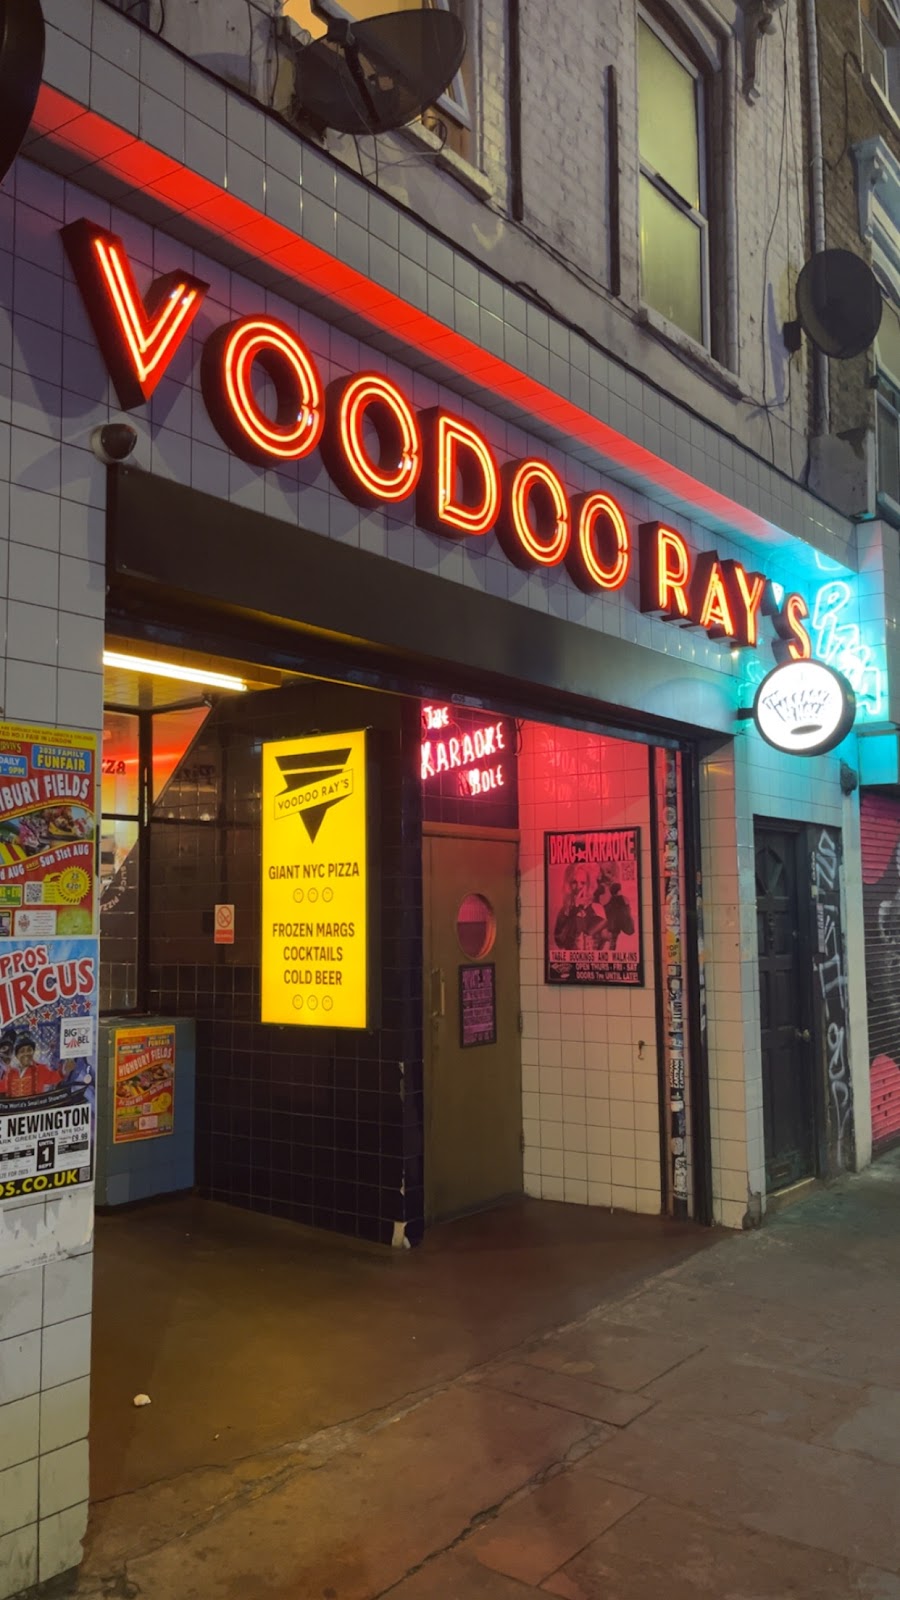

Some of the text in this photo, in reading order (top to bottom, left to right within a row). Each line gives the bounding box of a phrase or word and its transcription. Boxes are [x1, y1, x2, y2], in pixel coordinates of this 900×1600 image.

[62, 217, 812, 660] VOODOO RAY'S
[58, 749, 84, 757] FAMILY
[421, 722, 505, 779] KARAOKE
[38, 754, 86, 771] FUNFAIR
[44, 773, 90, 799] FIELDS
[278, 778, 349, 811] VOODOO RAY'S
[550, 831, 635, 865] DRAG KARAOKE
[8, 863, 25, 880] AUG
[40, 855, 55, 867] Sun
[55, 847, 71, 861] 31st
[73, 844, 90, 856] AUG
[269, 862, 360, 880] GIANT NYC PIZZA
[272, 922, 355, 938] FROZEN MARGS
[283, 946, 343, 962] COCKTAILS
[552, 952, 637, 962] TABLE BOOKINGS AND WALK-INS
[283, 969, 342, 986] COLD BEER
[64, 1028, 77, 1037] BIG
[118, 1046, 173, 1077] HIGHBURY FIELDS
[7, 1106, 89, 1137] NEWINGTON
[14, 1134, 37, 1142] GREEN
[38, 1130, 58, 1138] LANES
[42, 1147, 50, 1162] 1
